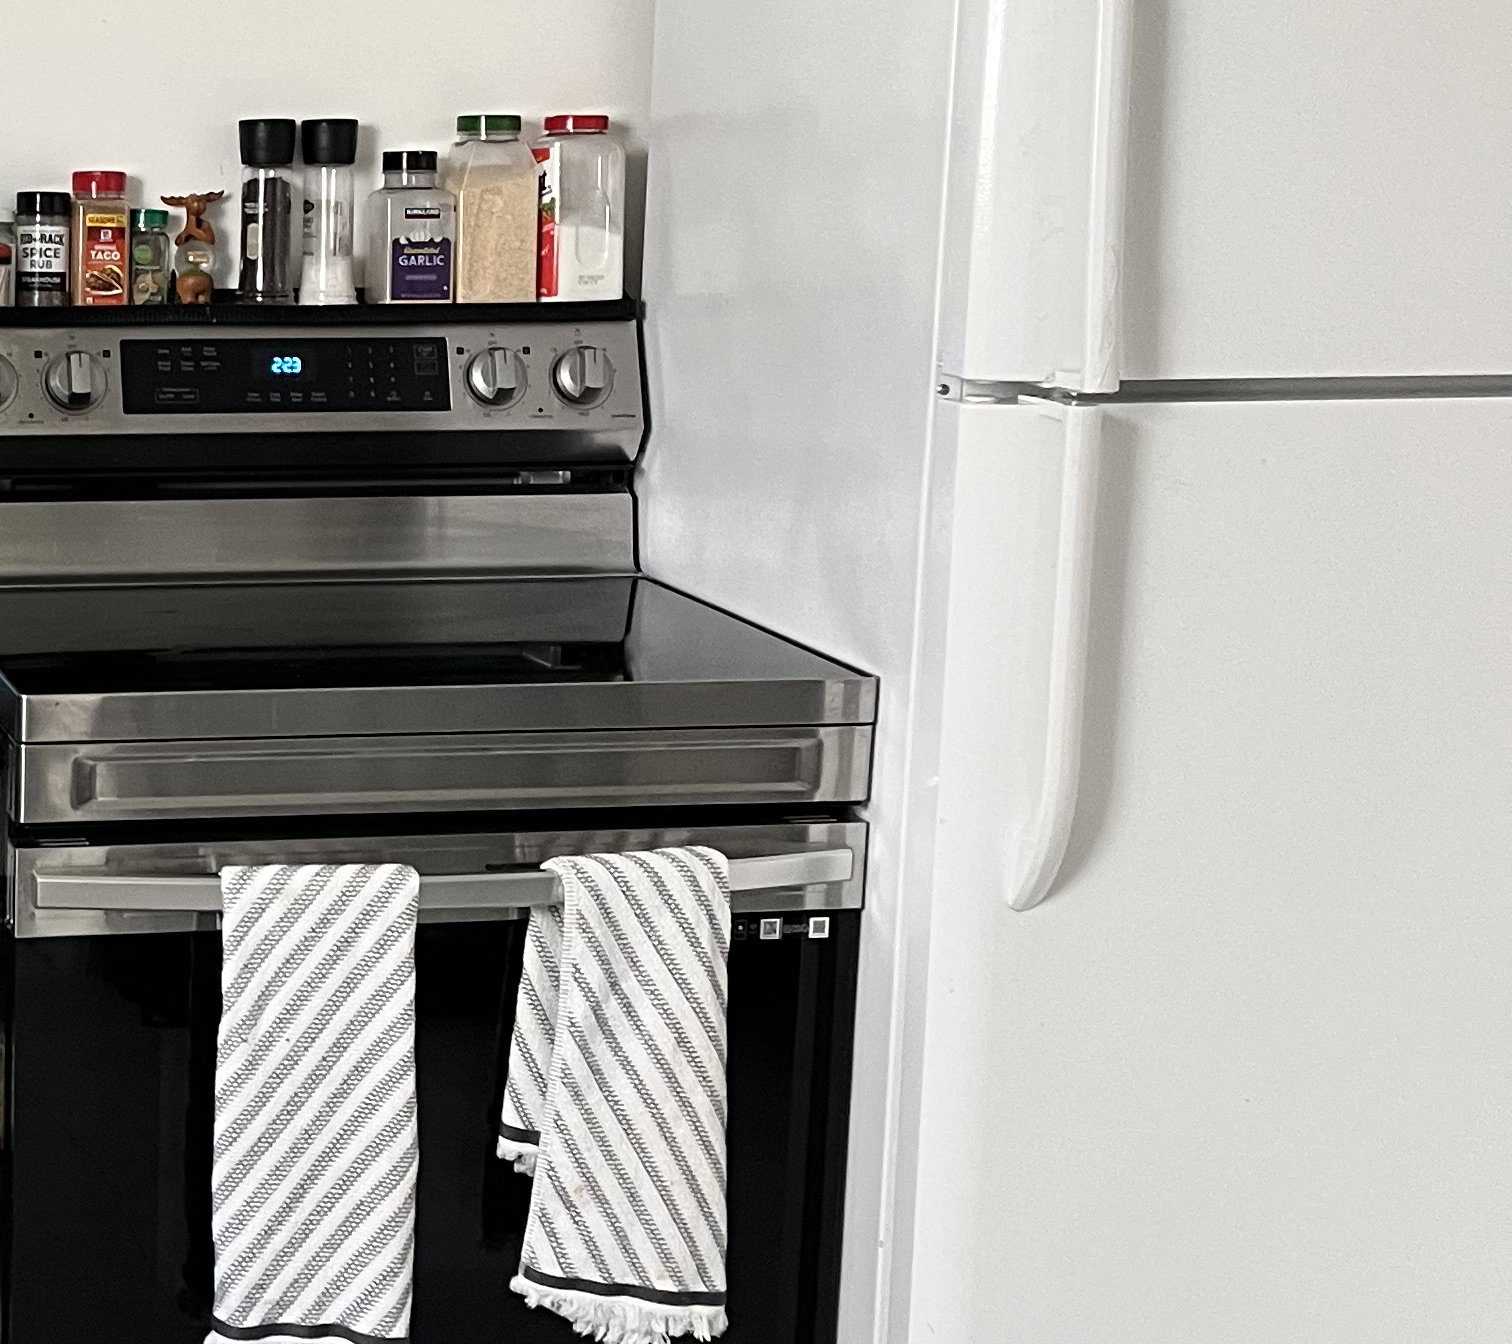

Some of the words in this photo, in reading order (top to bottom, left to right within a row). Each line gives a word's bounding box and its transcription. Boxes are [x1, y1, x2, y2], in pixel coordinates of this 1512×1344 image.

[22, 247, 61, 259] SPICE
[90, 250, 121, 261] TACO
[30, 259, 53, 269] RUB
[398, 255, 445, 266] GARLIC
